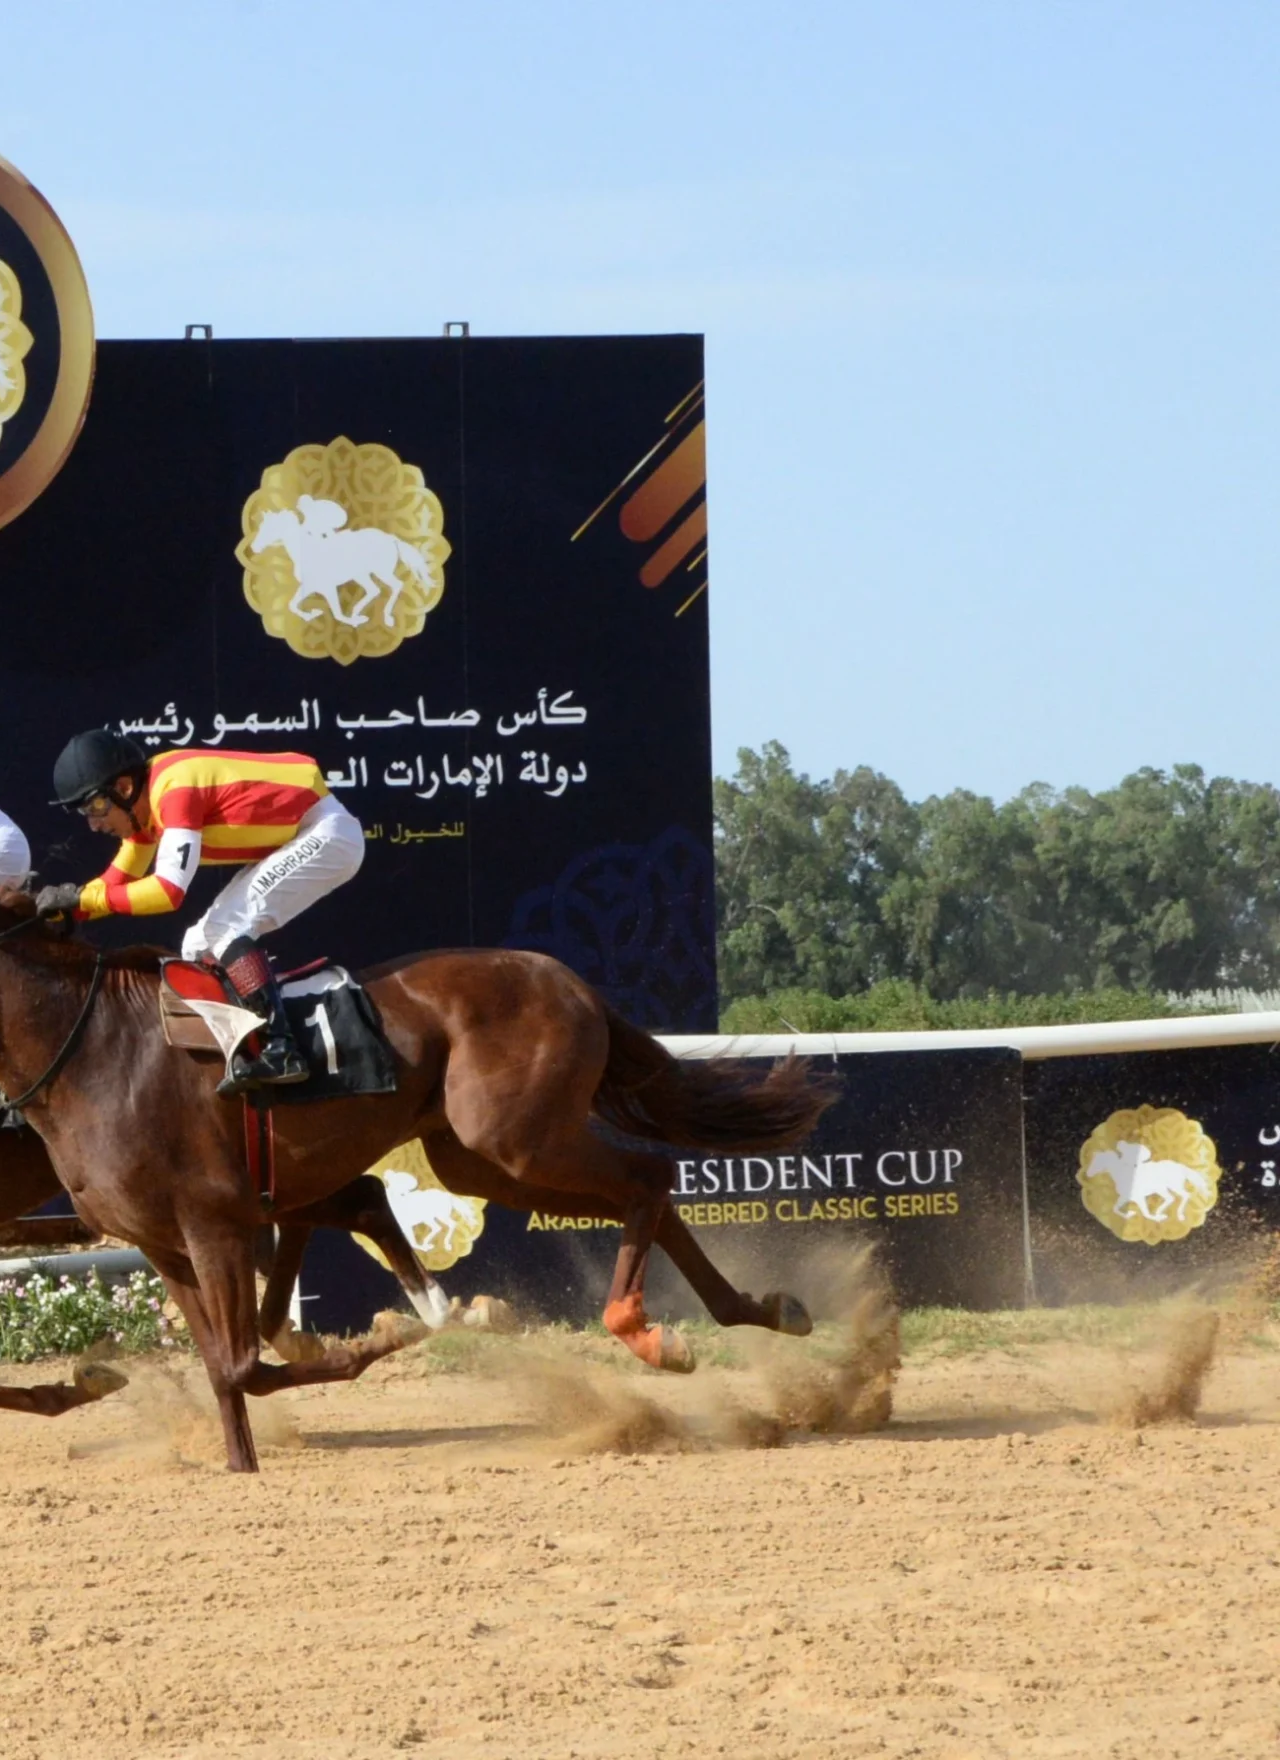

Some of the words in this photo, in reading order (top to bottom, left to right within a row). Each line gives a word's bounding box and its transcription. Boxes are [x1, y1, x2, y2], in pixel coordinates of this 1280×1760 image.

[201, 698, 321, 745] السمو
[336, 696, 481, 740] صاحب
[496, 687, 588, 736] كأس
[383, 754, 504, 799] الإمارات
[519, 750, 588, 798] دولة
[390, 821, 464, 844] للخيول
[176, 842, 192, 871] 1
[304, 1003, 340, 1075] 1
[669, 1154, 863, 1195] ESIDENT
[876, 1148, 963, 1185] CUP
[676, 1202, 769, 1226] REBRED
[775, 1198, 876, 1222] CLASSIC
[884, 1192, 959, 1217] SERIES
